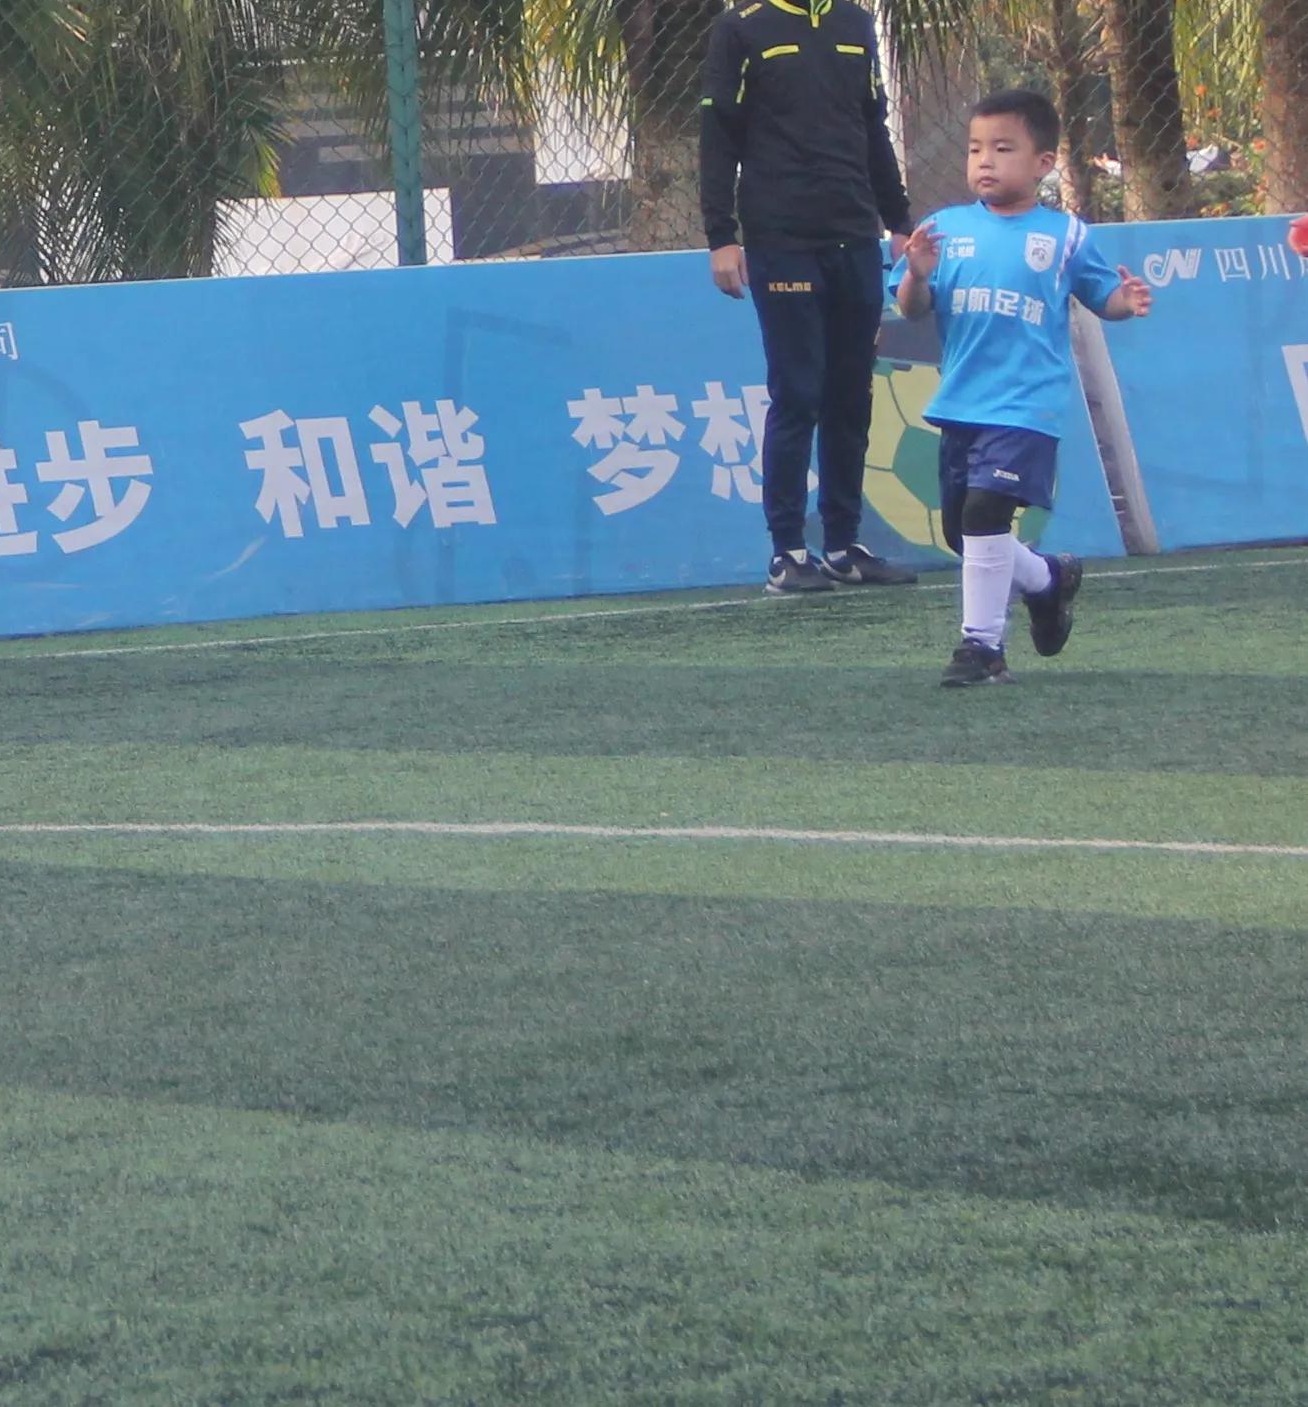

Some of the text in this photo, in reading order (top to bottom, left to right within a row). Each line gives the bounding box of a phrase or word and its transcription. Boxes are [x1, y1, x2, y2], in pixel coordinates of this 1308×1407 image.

[1215, 243, 1308, 283] 四川
[238, 399, 497, 539] 和谐
[566, 381, 805, 517] 梦想
